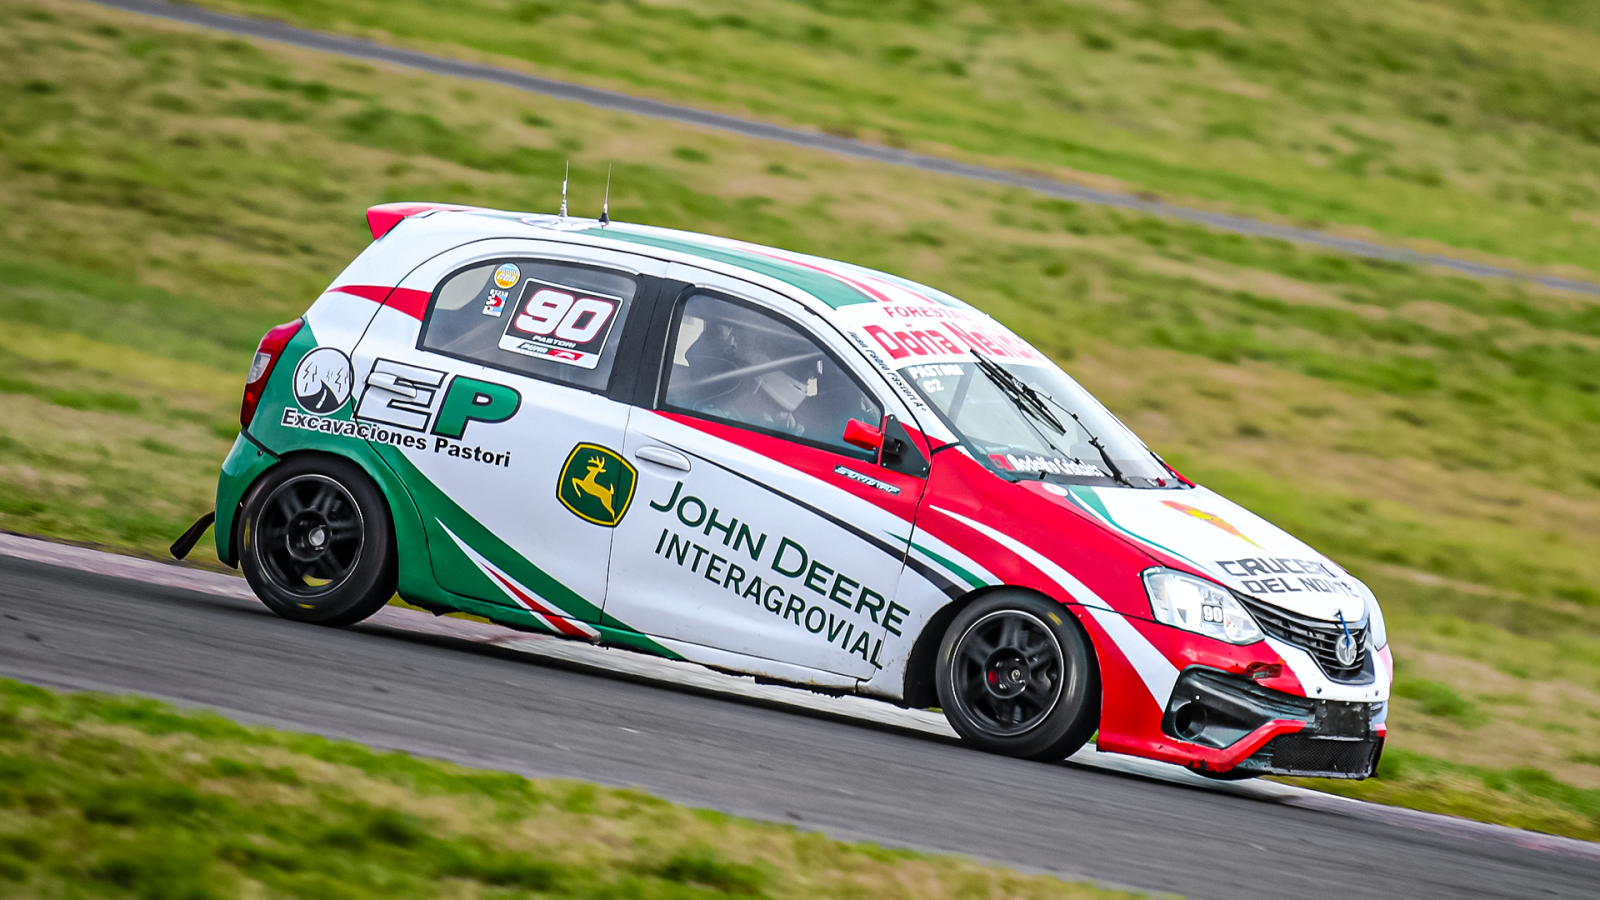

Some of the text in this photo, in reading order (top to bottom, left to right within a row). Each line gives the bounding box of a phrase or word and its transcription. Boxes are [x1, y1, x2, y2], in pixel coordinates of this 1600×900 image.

[514, 288, 615, 344] 90
[882, 306, 972, 321] FORESTAL
[520, 343, 549, 354] PUMA
[532, 335, 577, 349] PASTORI
[862, 324, 966, 360] Doña
[908, 364, 964, 380] PASTORI
[922, 377, 945, 394] C2
[352, 358, 522, 441] EP
[281, 406, 511, 468] Excavaciones Pastori
[1006, 453, 1061, 475] Rodolfo
[649, 481, 911, 637] JOHN DEERE
[1241, 577, 1302, 594] DEL
[655, 528, 884, 670] INTERAGROVIAL
[1203, 605, 1223, 623] 90
